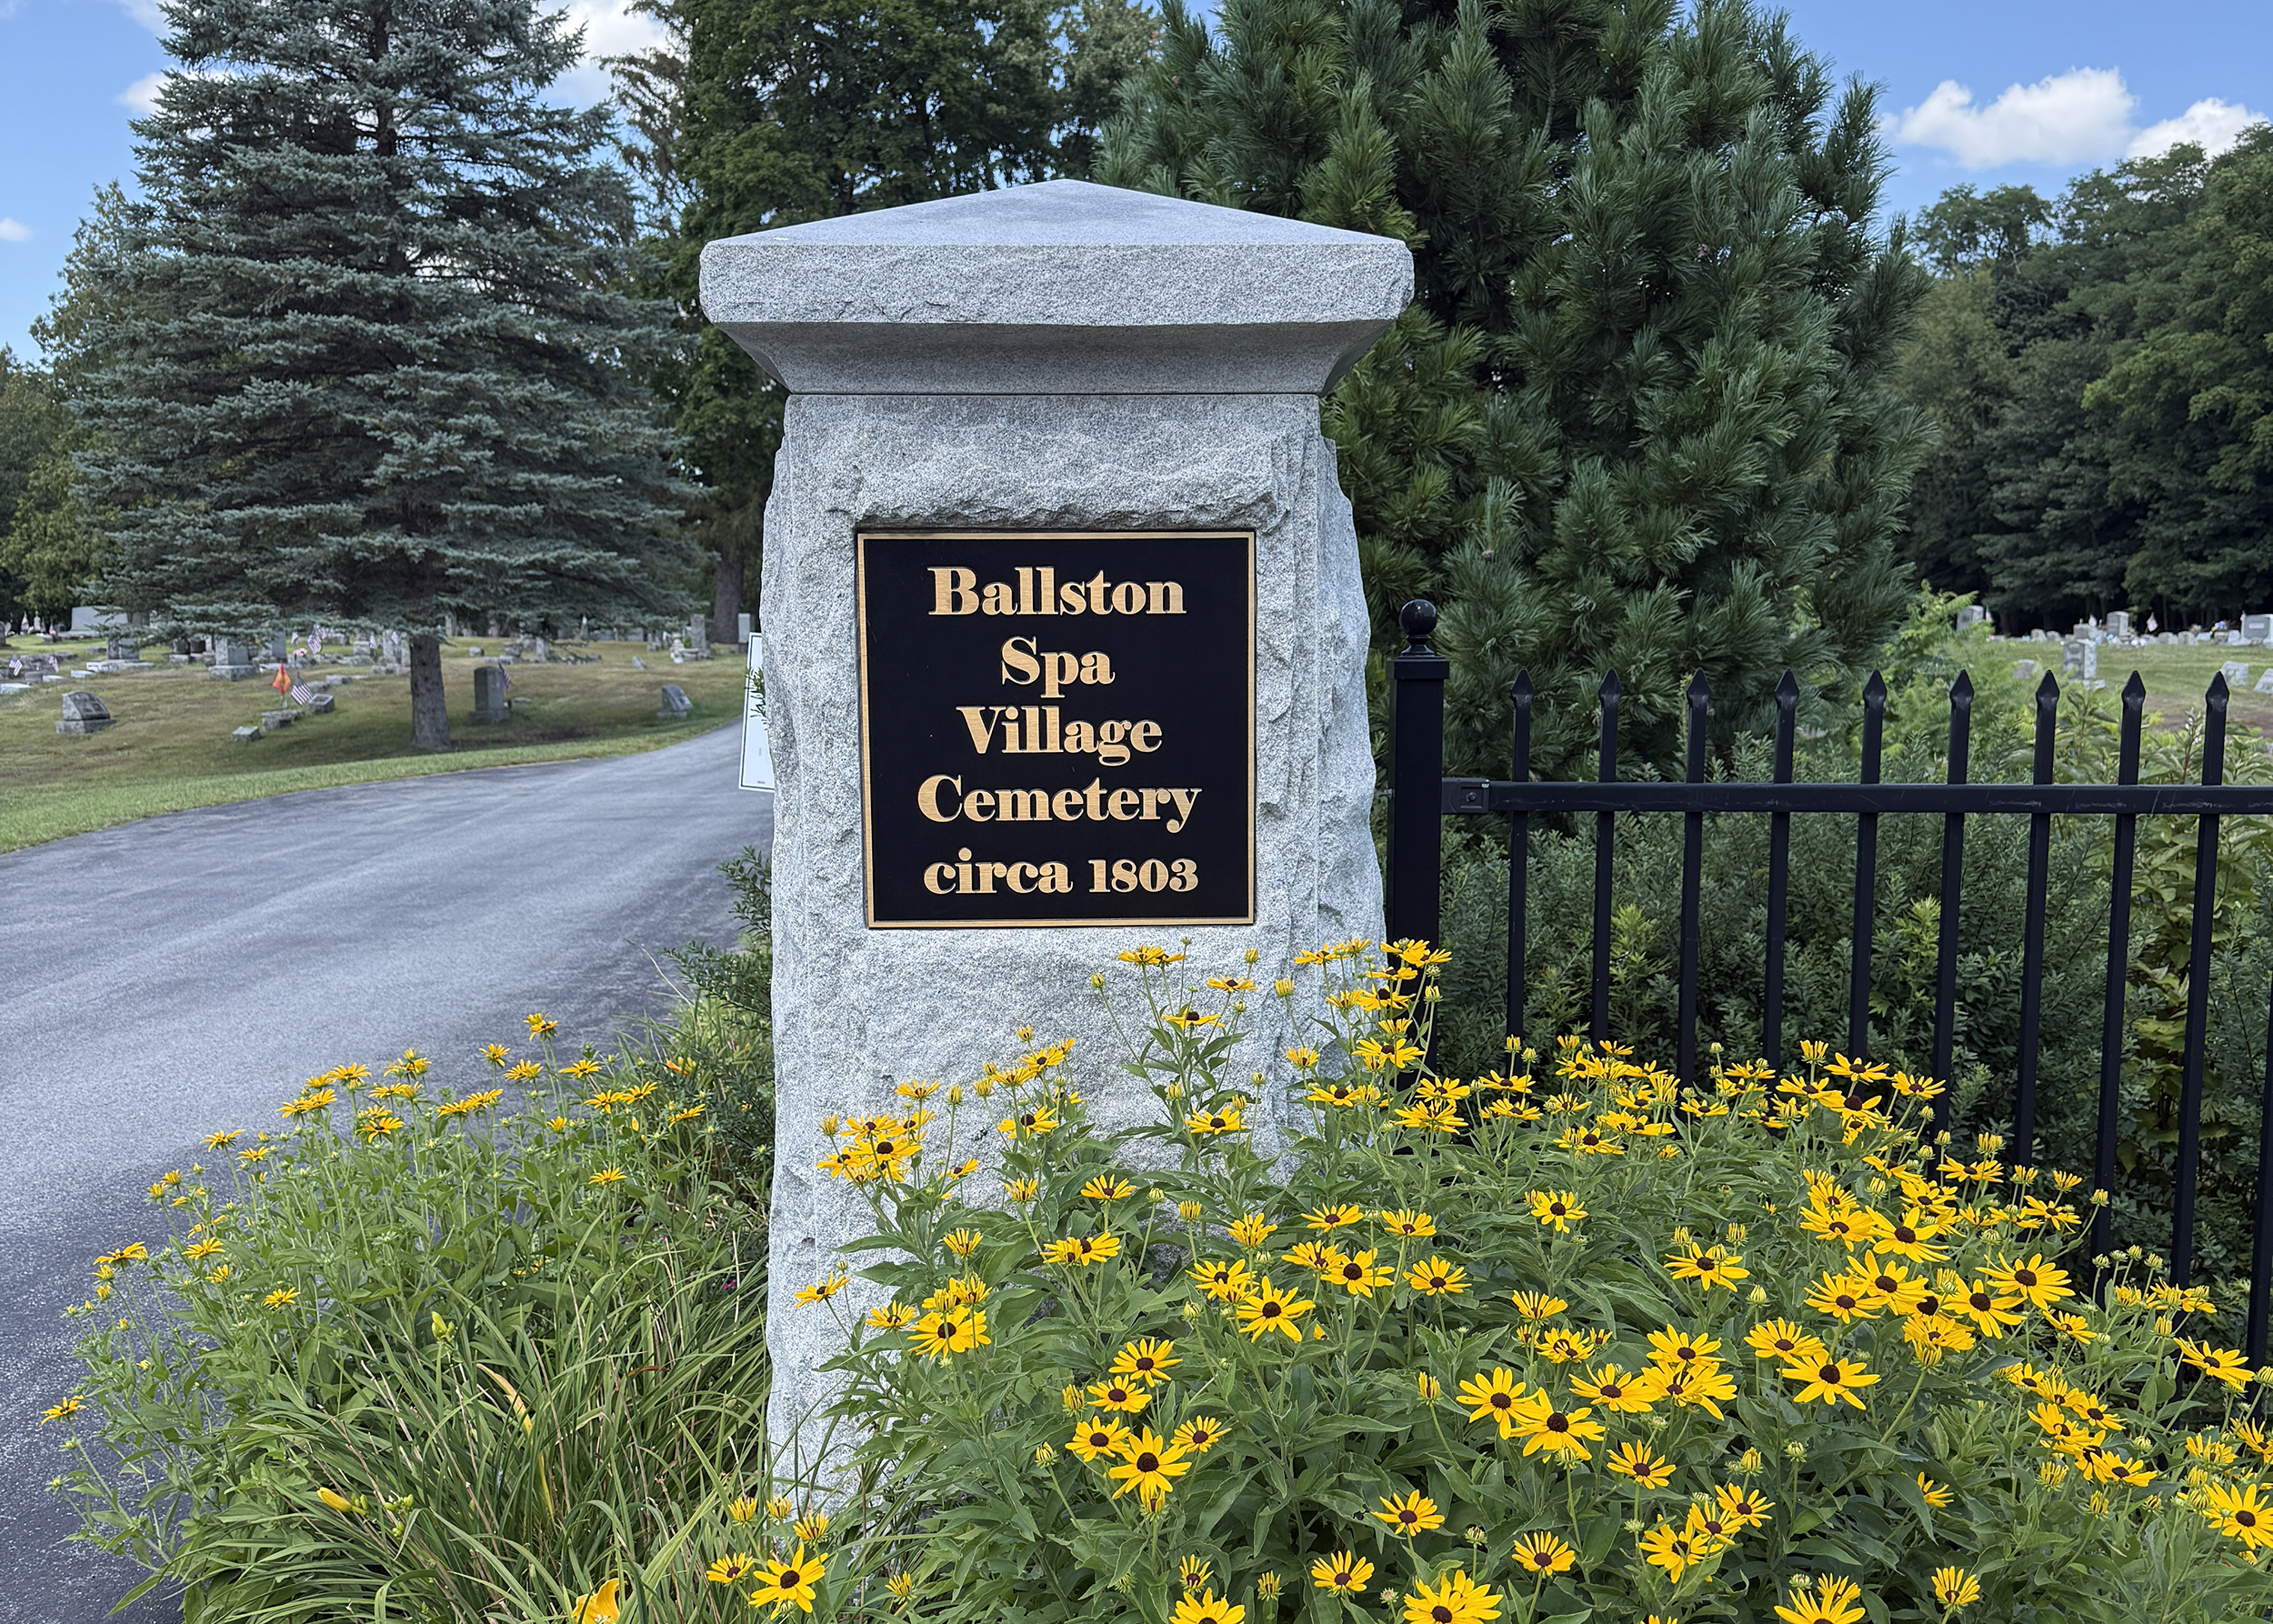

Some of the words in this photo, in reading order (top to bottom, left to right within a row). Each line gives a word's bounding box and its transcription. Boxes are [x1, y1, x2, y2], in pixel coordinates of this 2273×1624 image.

[927, 566, 1187, 616] Ballston
[1001, 636, 1115, 697] Spa
[956, 706, 1162, 766] Village
[918, 775, 1202, 833] Cemetery
[924, 847, 1073, 894] circa
[1088, 858, 1198, 892] 1803
